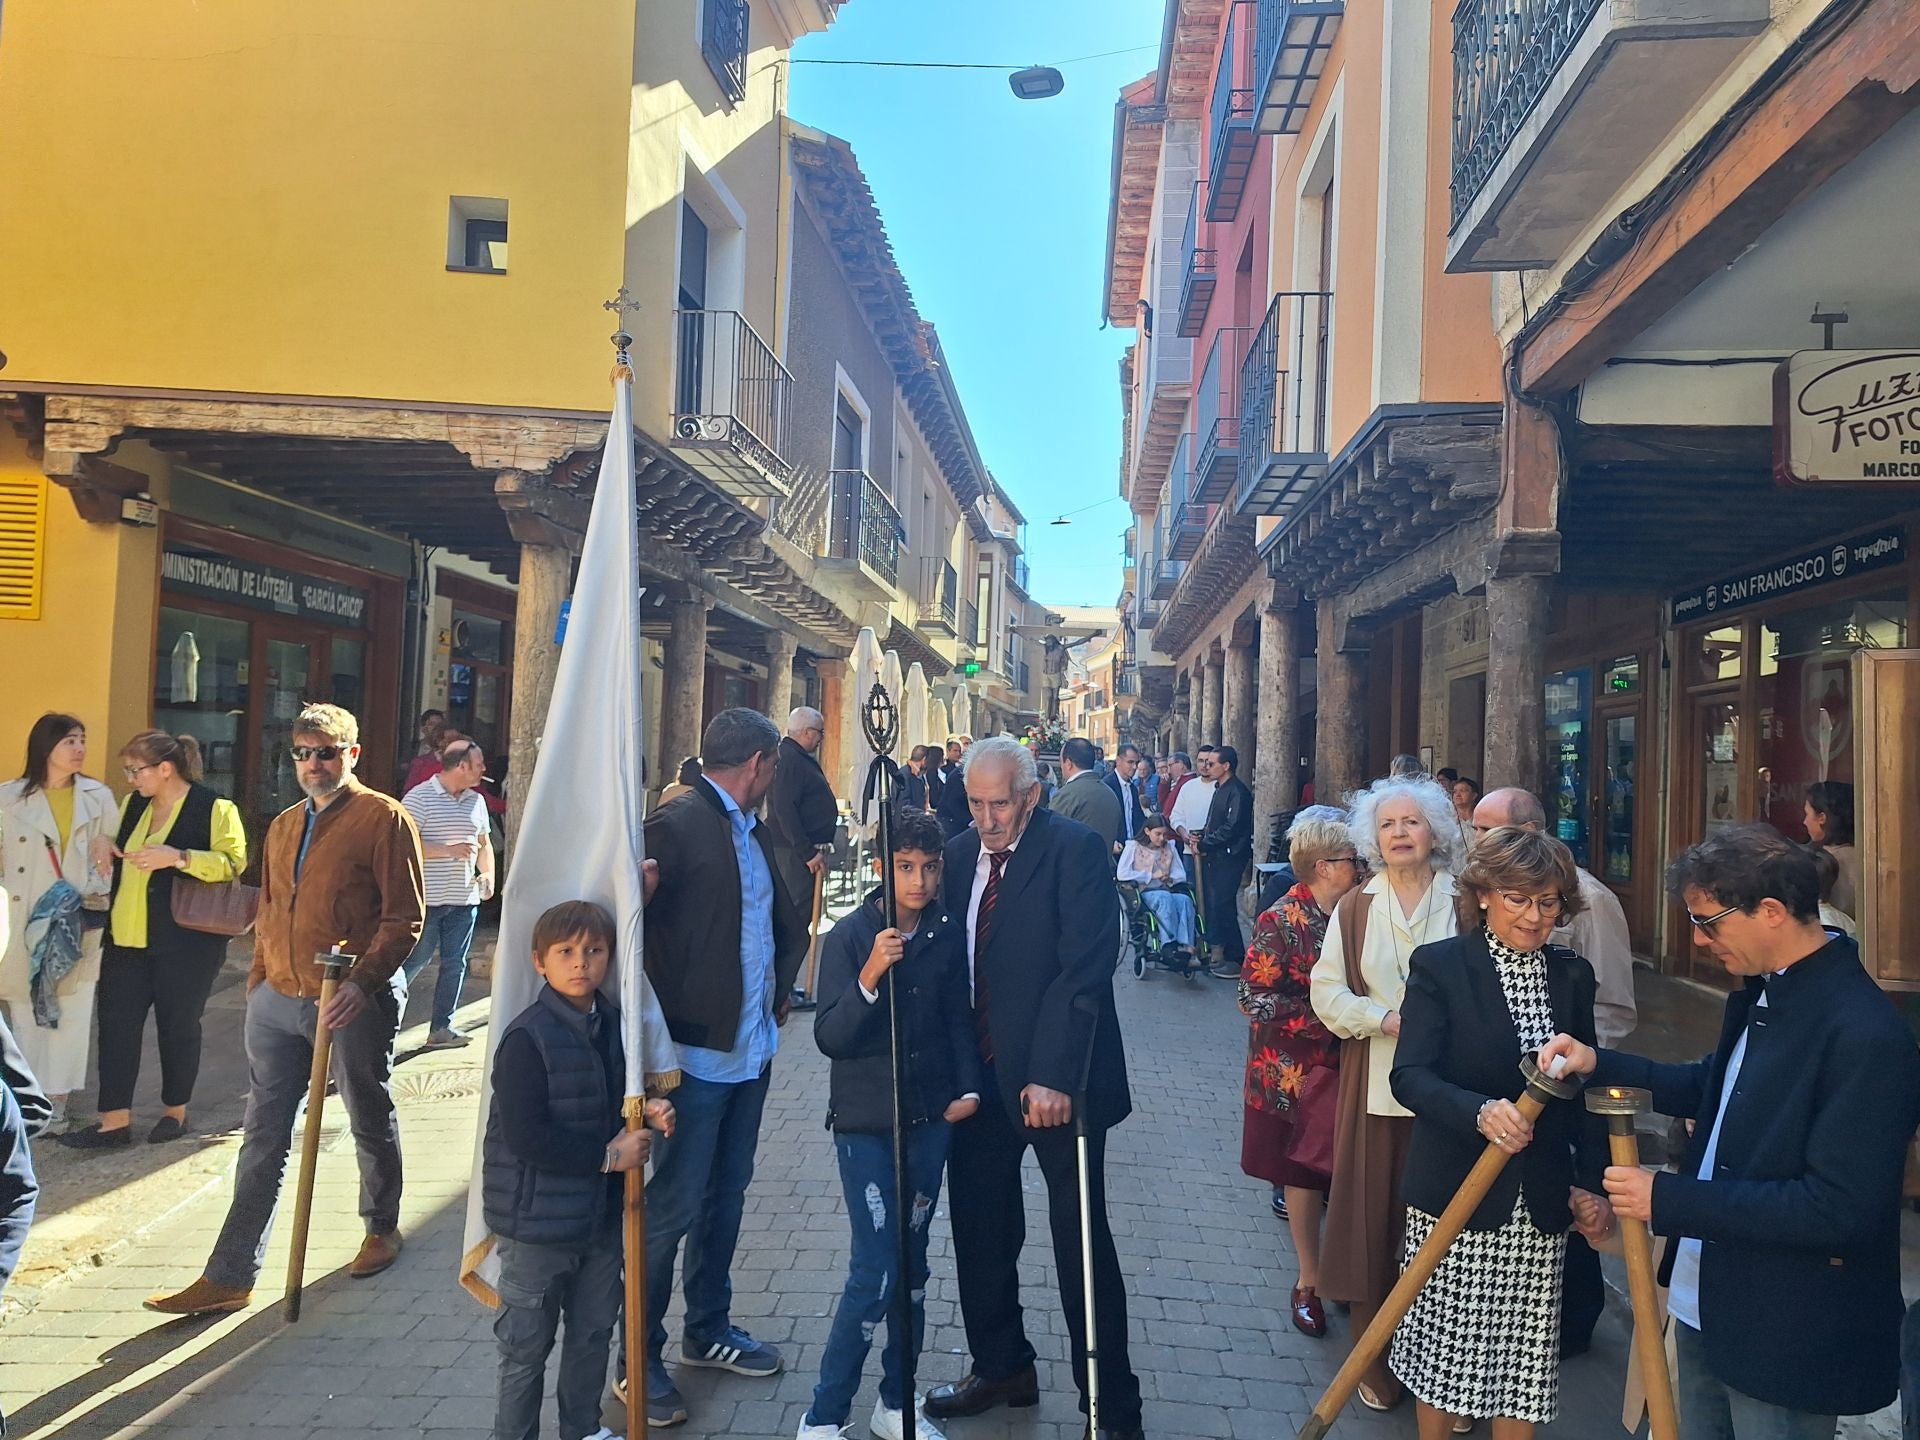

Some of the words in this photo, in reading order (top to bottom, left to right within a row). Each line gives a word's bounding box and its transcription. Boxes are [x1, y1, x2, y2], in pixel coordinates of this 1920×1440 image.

[1798, 353, 1920, 453] Guz
[1863, 462, 1920, 478] MARCO
[242, 571, 255, 596] DE
[256, 576, 294, 604] LOTERÍA
[1722, 579, 1748, 603] SAN
[1750, 556, 1825, 596] FRANCISCO
